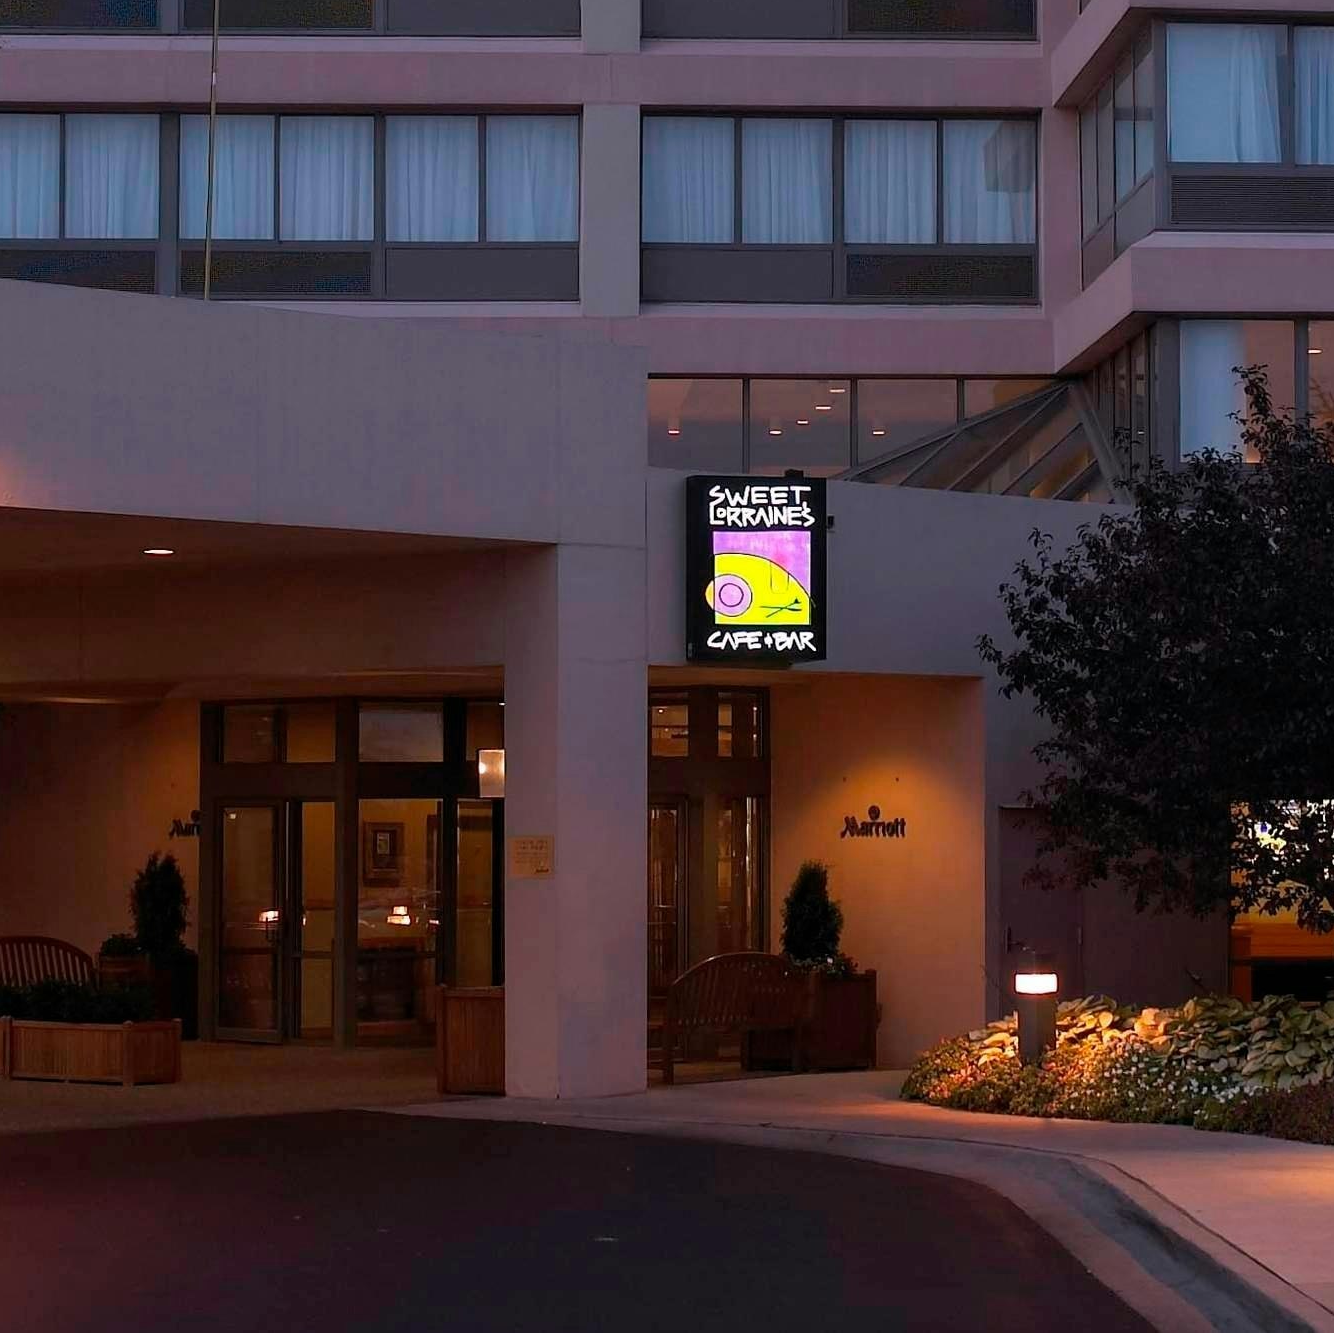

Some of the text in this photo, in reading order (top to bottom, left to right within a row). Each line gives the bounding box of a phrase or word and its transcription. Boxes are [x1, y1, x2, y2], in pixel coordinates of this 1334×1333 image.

[709, 485, 811, 506] SWEET
[707, 631, 762, 650] CAFE
[774, 631, 816, 651] BAR
[840, 816, 906, 838] Marriott
